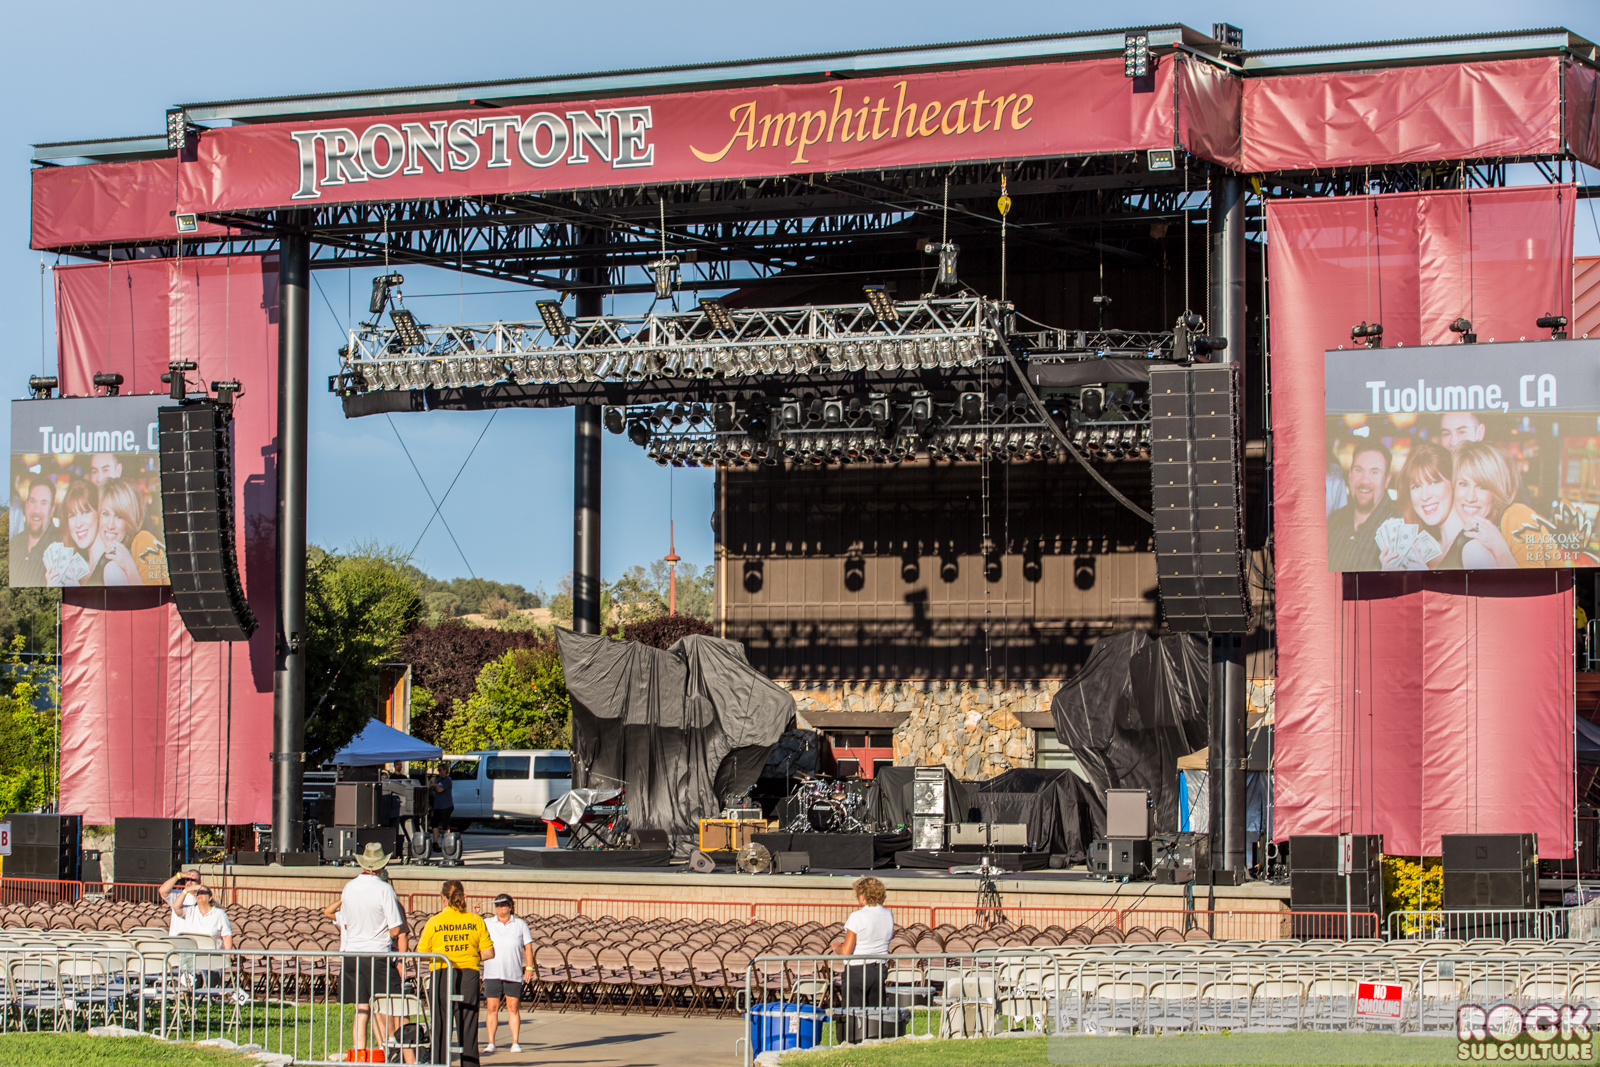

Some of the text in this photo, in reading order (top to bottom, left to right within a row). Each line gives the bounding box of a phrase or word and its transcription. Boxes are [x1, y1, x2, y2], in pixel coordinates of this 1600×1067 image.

[291, 81, 1034, 200] IRONSTONE Amphitheatre
[1365, 373, 1557, 414] Tuolumne, CA
[39, 422, 160, 455] Tuolumne, C
[1525, 533, 1580, 544] BLACK OAK
[1525, 543, 1580, 551] CASINO
[1526, 551, 1580, 561] RESORT
[148, 571, 168, 580] RES
[1, 830, 9, 847] B
[1346, 843, 1351, 863] C
[434, 922, 478, 933] LANDMARK
[443, 933, 470, 942] EVENT
[444, 943, 469, 952] STAFF
[1373, 985, 1387, 1000] NO
[1357, 998, 1400, 1016] SMOKING
